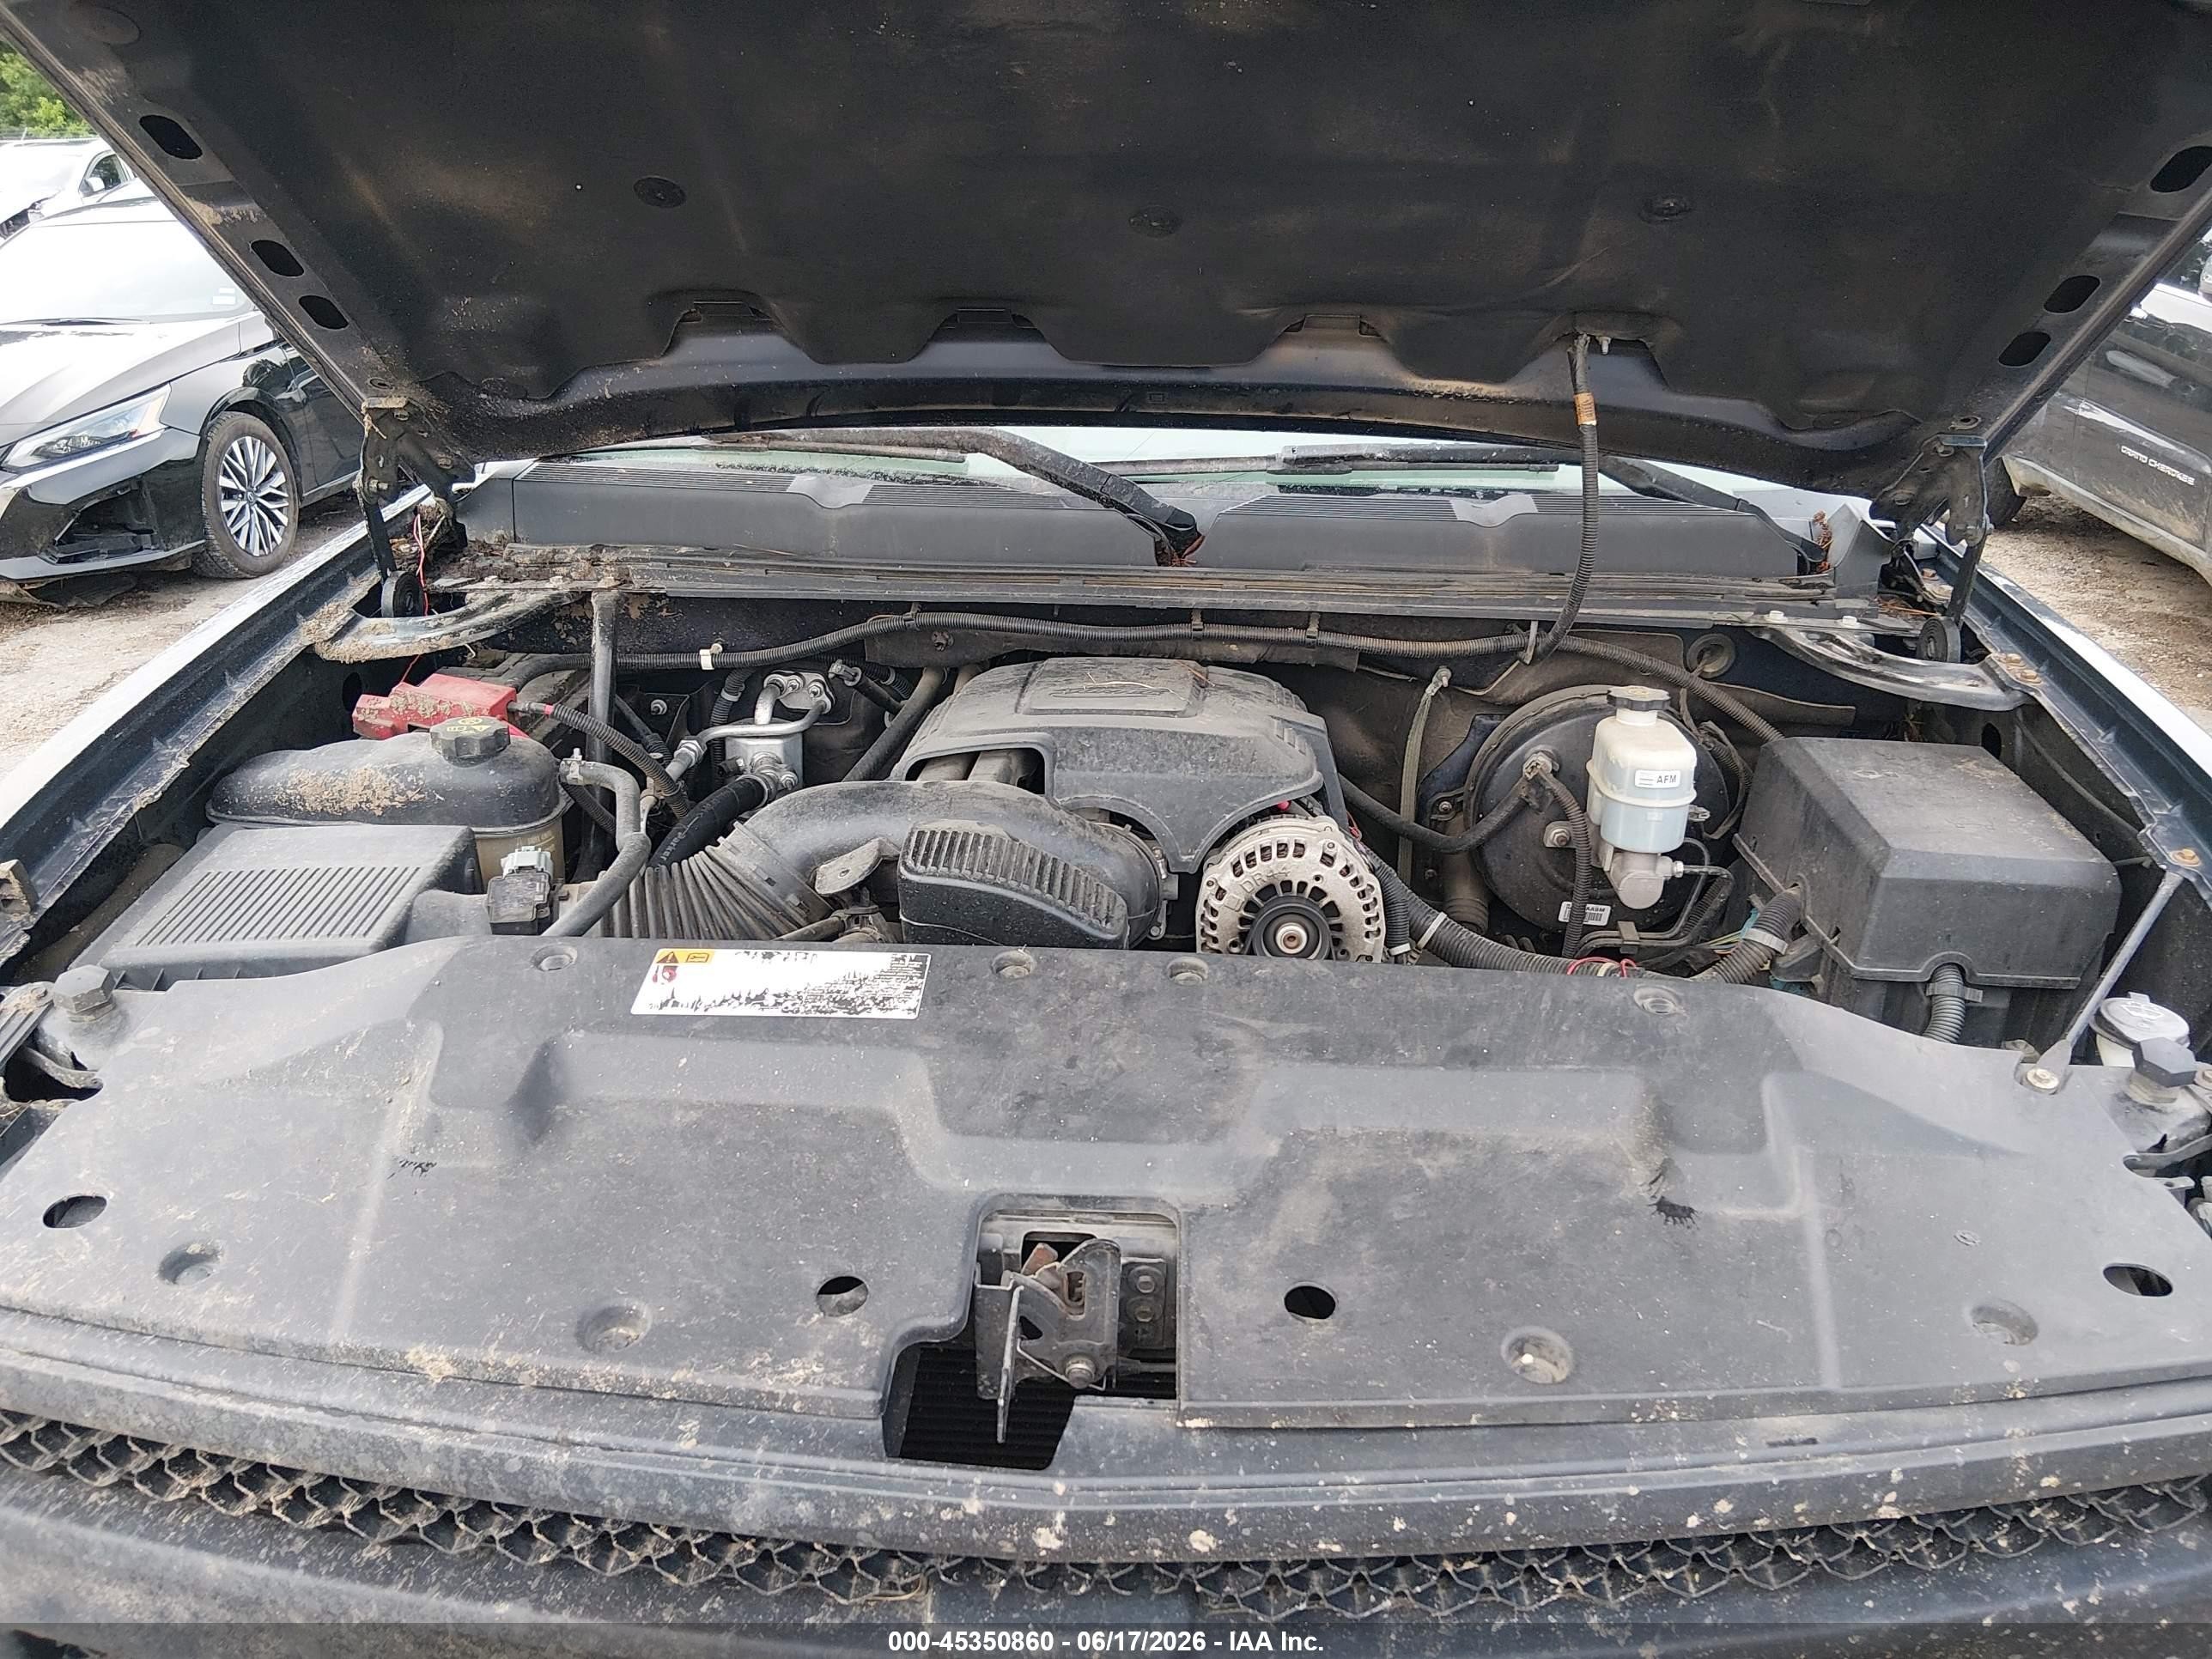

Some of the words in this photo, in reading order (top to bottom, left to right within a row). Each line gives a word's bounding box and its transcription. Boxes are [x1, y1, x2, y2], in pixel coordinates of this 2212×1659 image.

[2121, 445, 2148, 464] GRAND
[2148, 458, 2195, 486] CHEROKEE
[1656, 775, 1677, 784] AFM
[659, 831, 686, 861] Parker
